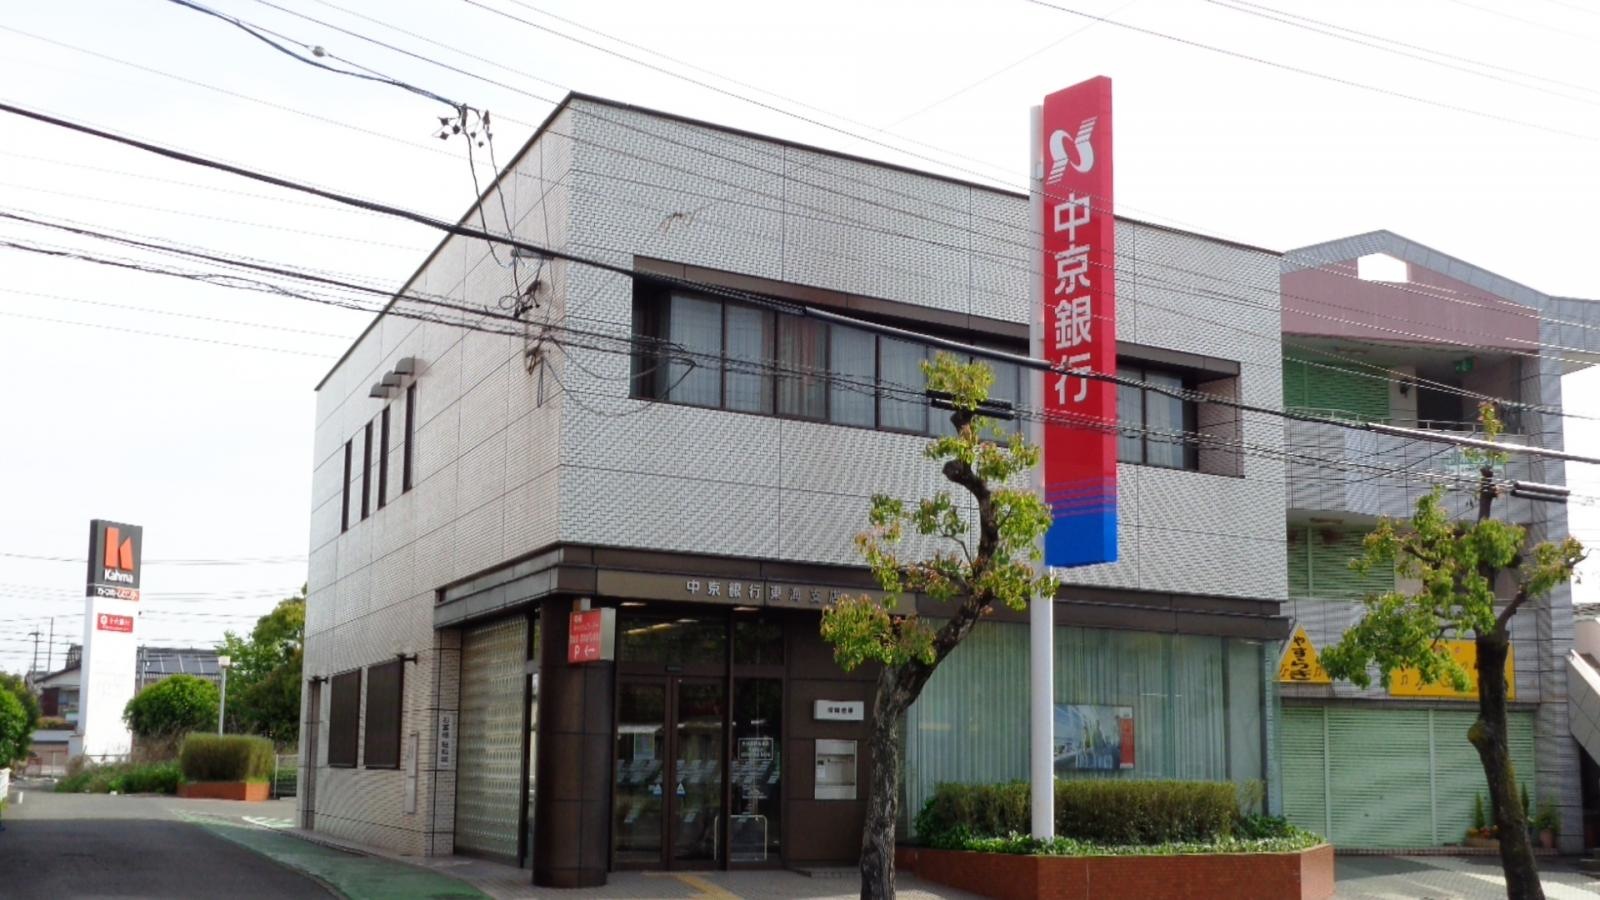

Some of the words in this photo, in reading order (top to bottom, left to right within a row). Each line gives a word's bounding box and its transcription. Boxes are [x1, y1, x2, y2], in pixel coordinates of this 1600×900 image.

[1054, 192, 1092, 405] 中京銀行
[105, 569, 133, 583] Kahma
[686, 579, 842, 604] 中京銀行東海支店
